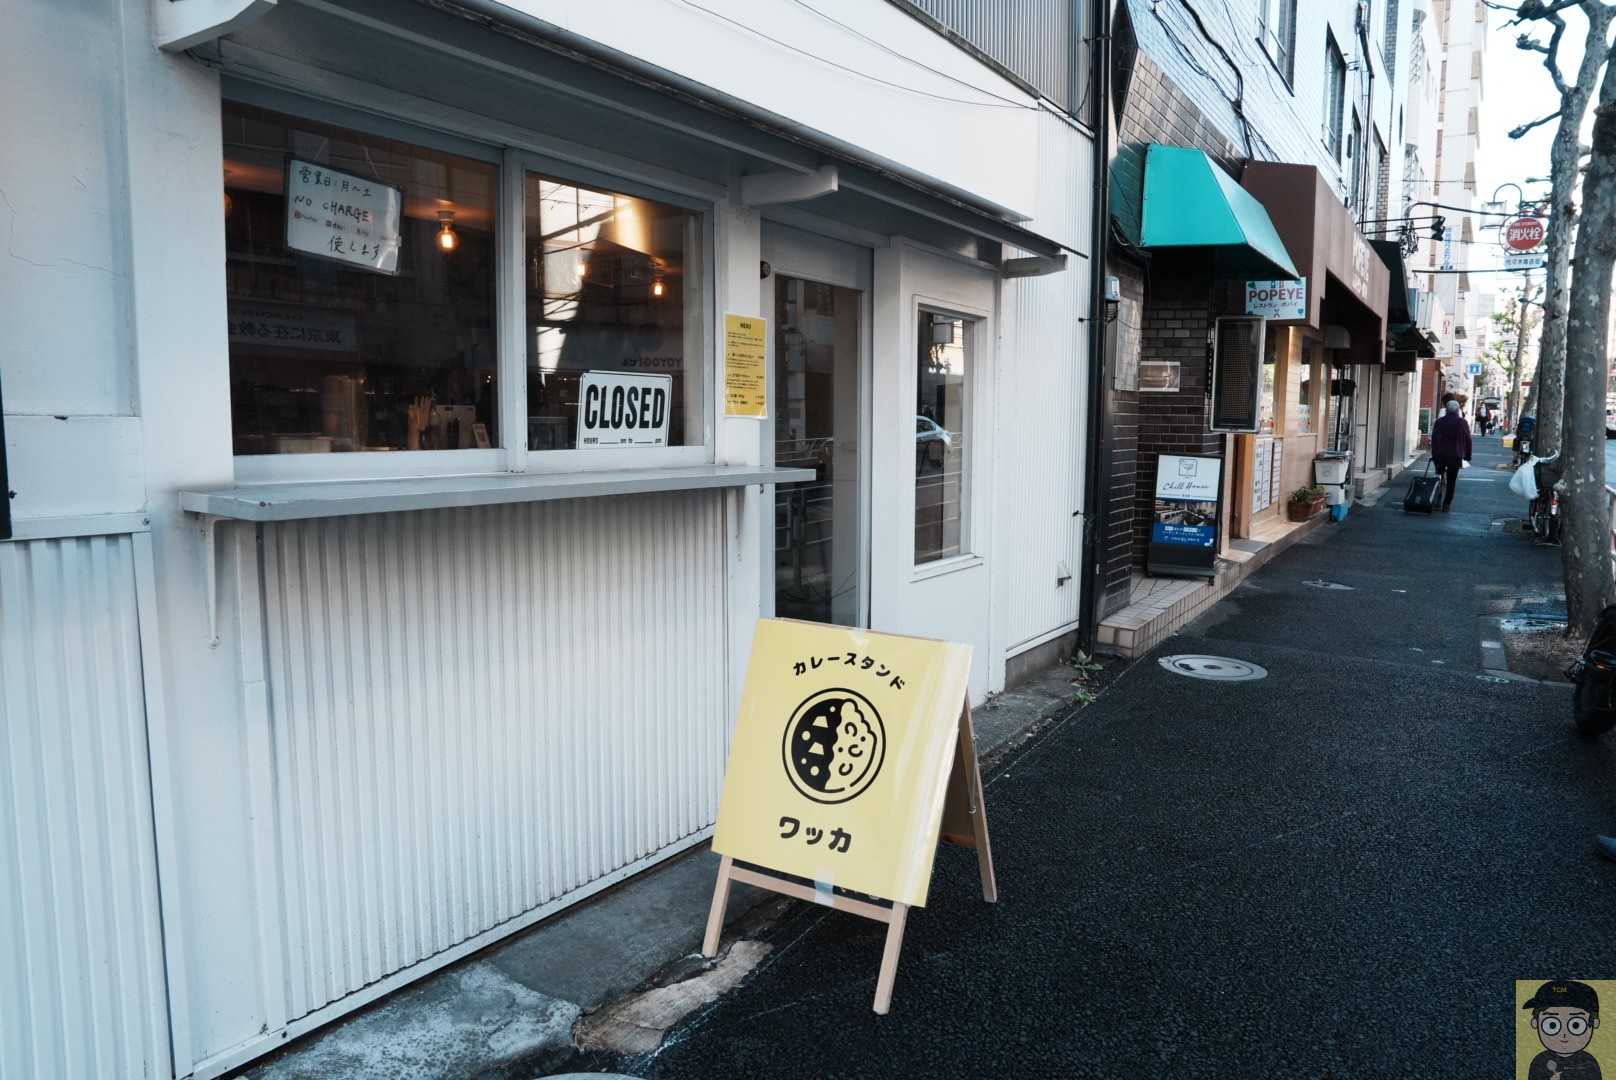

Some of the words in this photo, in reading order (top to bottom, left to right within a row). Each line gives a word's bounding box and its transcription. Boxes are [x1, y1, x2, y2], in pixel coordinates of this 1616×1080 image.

[294, 196, 312, 206] NO
[1508, 227, 1541, 242] 消火栓
[1249, 288, 1304, 302] POPEYE
[739, 322, 752, 330] MENU
[584, 384, 665, 429] CLOSED
[583, 437, 599, 445] HOURS
[1163, 481, 1185, 491] Chill
[1185, 481, 1212, 491] House
[793, 652, 906, 690] カレースタンド
[779, 816, 852, 853] ワッカ
